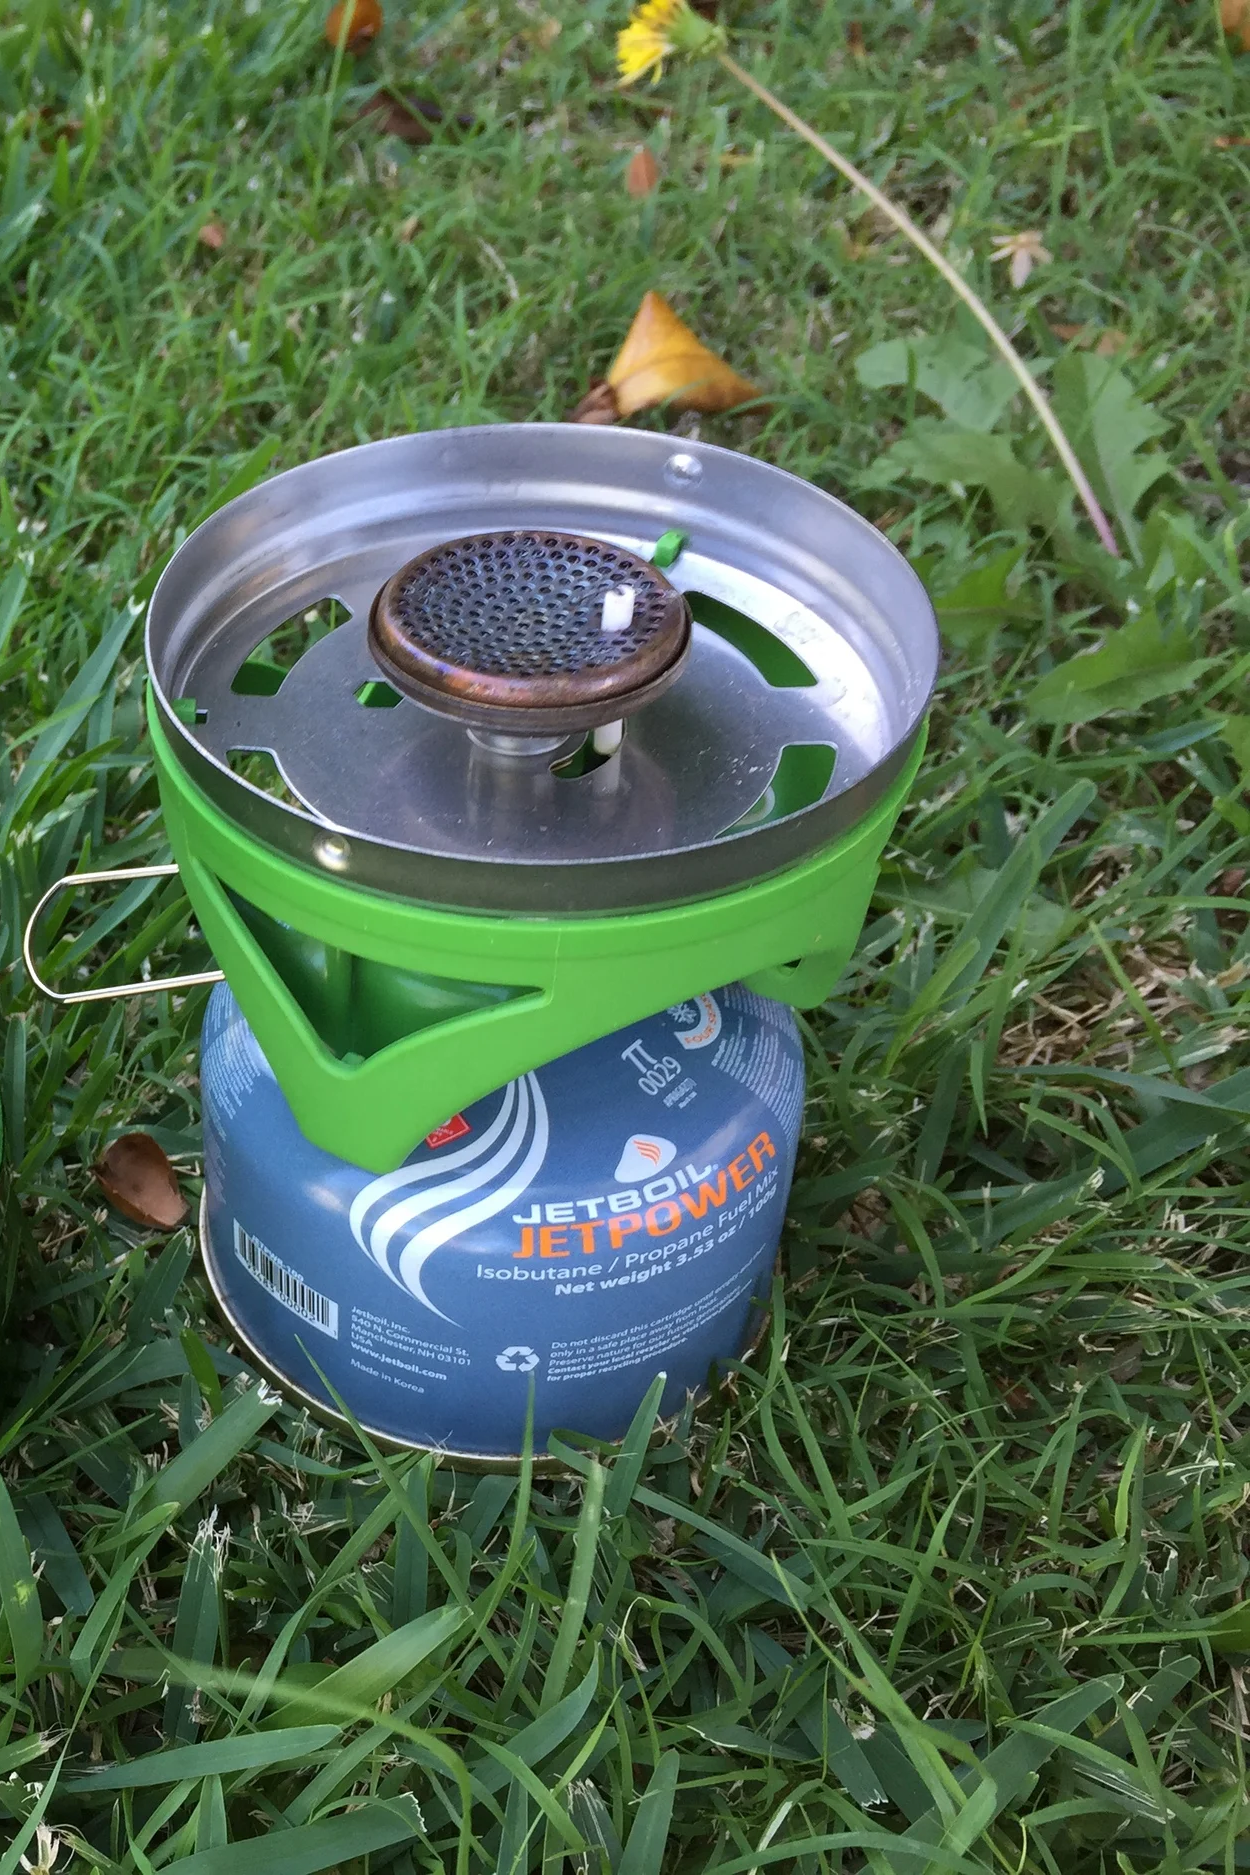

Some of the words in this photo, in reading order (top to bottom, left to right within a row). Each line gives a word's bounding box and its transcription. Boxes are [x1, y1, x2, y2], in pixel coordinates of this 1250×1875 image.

[638, 1056, 682, 1096] 0029
[512, 1163, 713, 1225] JETBOIL
[512, 1131, 777, 1259] JETPOWER
[476, 1263, 603, 1282] Isobutane
[608, 1257, 620, 1274] /
[625, 1224, 713, 1268] Propane
[719, 1191, 752, 1228] Fuel
[755, 1164, 778, 1198] Mix
[554, 1281, 595, 1296] Net
[599, 1260, 672, 1290] weight
[676, 1239, 715, 1267] 3.53
[717, 1224, 737, 1244] oz
[748, 1182, 778, 1219] 100g
[351, 1314, 371, 1327] 540
[373, 1323, 385, 1334] N.
[386, 1328, 453, 1354] Commercial
[455, 1347, 470, 1357] St.
[351, 1331, 373, 1347] USA
[351, 1322, 416, 1355] Manchester,
[417, 1347, 435, 1359] NH
[437, 1353, 471, 1366] 03101
[391, 1321, 411, 1334] Inc.
[549, 1355, 595, 1367] Preserve
[597, 1346, 630, 1359] nature
[632, 1340, 647, 1350] for
[648, 1333, 665, 1344] our
[667, 1319, 695, 1337] future
[550, 1349, 574, 1359] only
[597, 1340, 618, 1351] safe
[619, 1331, 647, 1347] place
[649, 1321, 674, 1336] away
[676, 1309, 698, 1324] from
[551, 1341, 568, 1350] Do
[570, 1338, 588, 1347] not
[590, 1328, 629, 1344] discard
[630, 1322, 649, 1334] this
[650, 1303, 693, 1328] cartridge
[350, 1340, 448, 1381] www.jetboil.com
[350, 1358, 380, 1377] Made
[393, 1377, 425, 1394] Korea
[547, 1374, 562, 1382] for
[563, 1369, 597, 1381] proper
[598, 1356, 641, 1374] recycling
[548, 1362, 586, 1374] Contact
[588, 1358, 611, 1369] your
[612, 1351, 634, 1363] local
[635, 1338, 672, 1356] recycler
